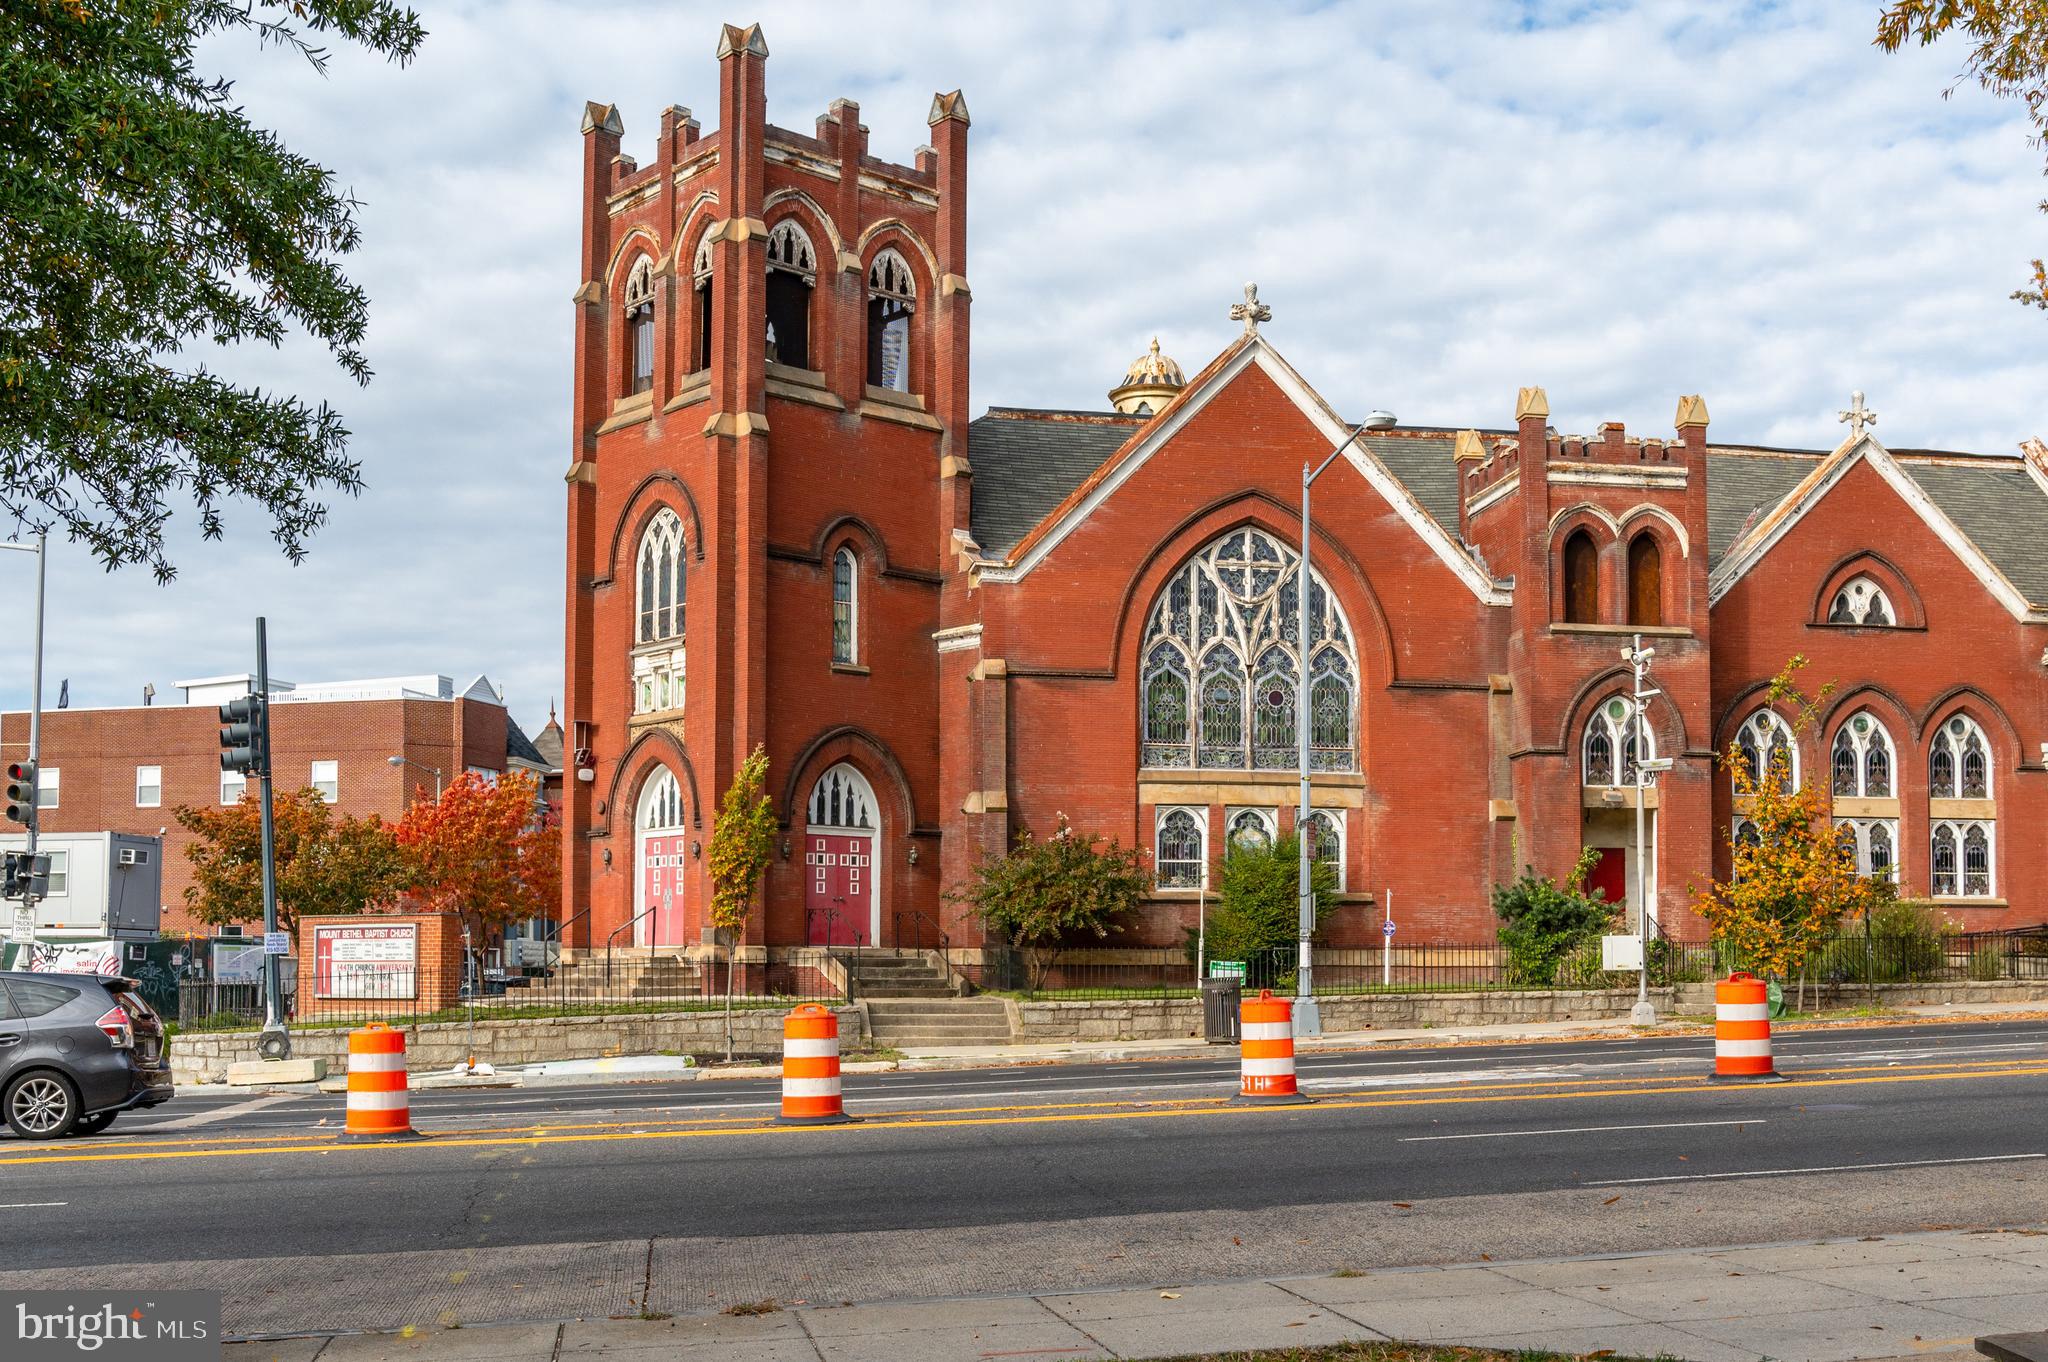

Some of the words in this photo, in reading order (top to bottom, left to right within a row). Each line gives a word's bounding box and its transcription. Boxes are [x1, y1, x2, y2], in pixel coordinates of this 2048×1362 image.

[319, 930, 341, 938] MOUNT
[342, 930, 362, 938] BETHEL
[364, 929, 388, 938] BAPTIST
[389, 928, 414, 938] CHURCH
[354, 963, 375, 971] CHURCH
[375, 963, 413, 971] ANNIVERSARY
